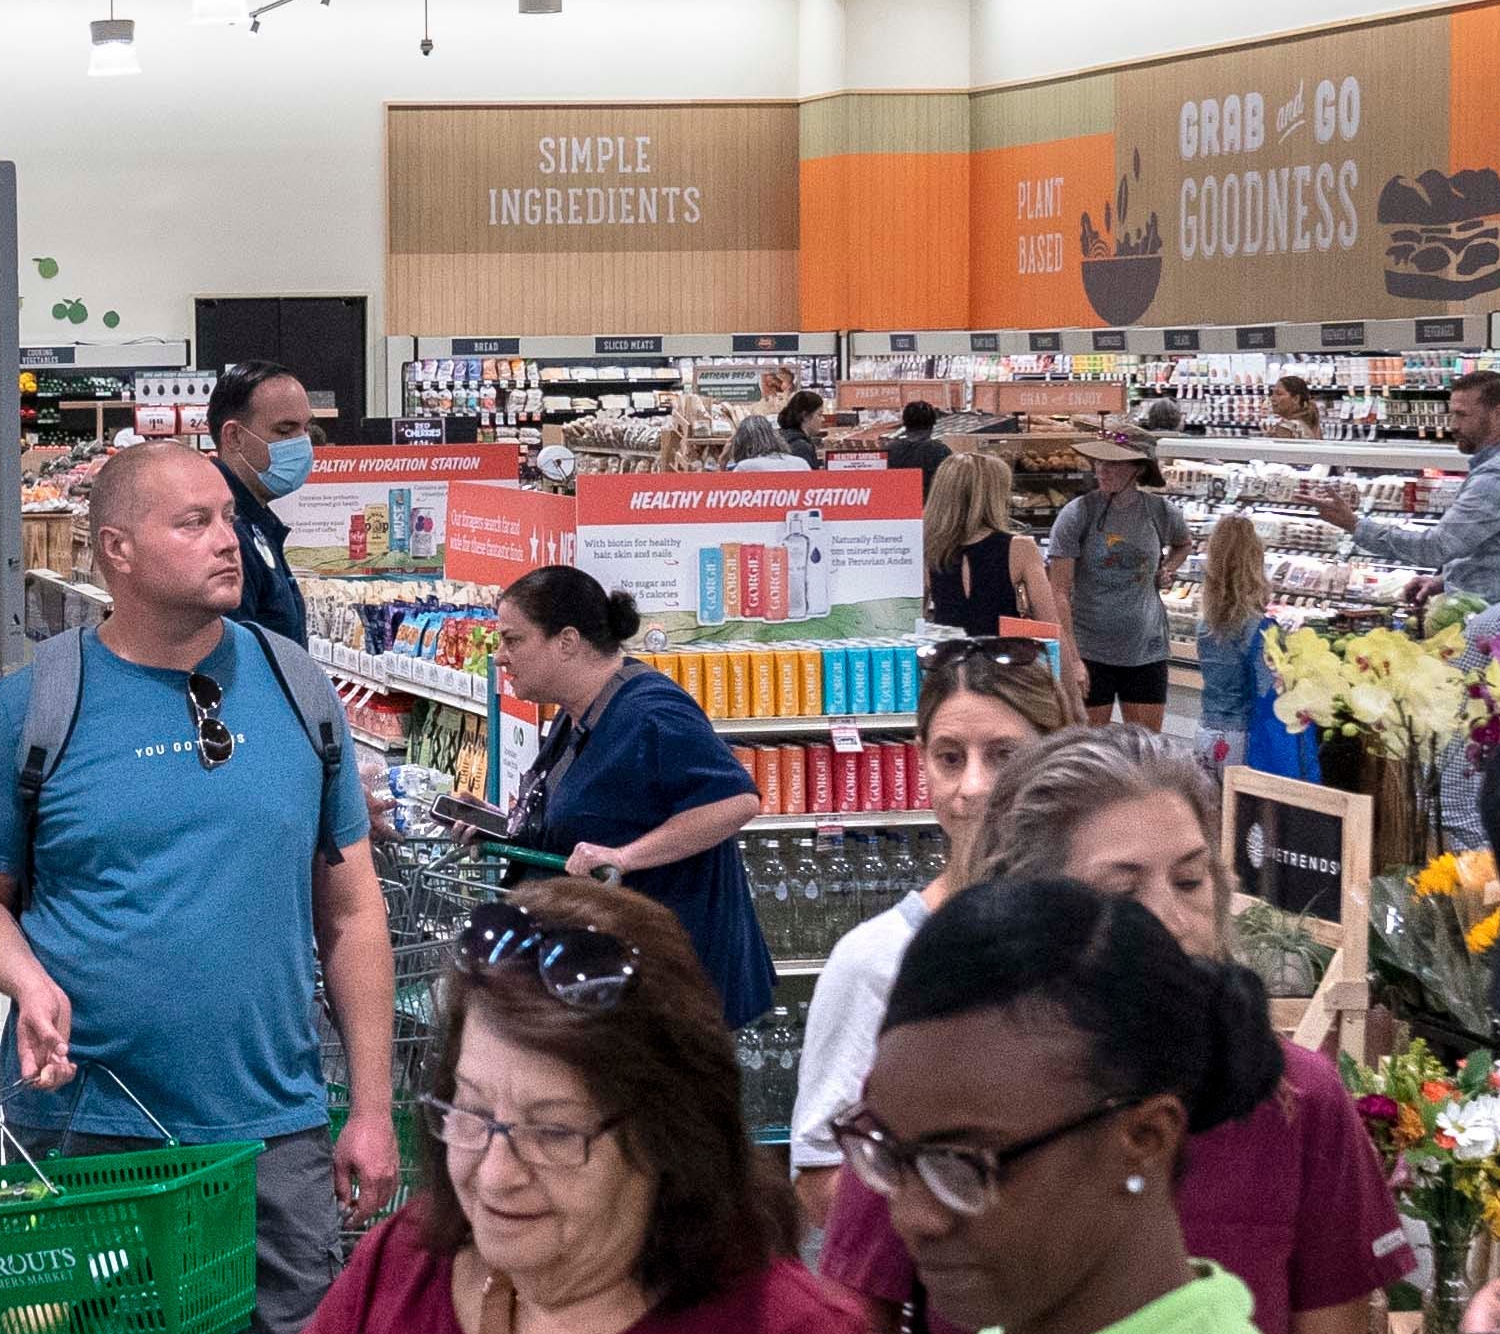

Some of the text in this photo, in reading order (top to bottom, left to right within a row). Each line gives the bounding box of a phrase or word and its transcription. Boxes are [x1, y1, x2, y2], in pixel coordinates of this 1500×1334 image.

[1179, 74, 1362, 162] GRAB and GO
[538, 135, 652, 175] SIMPLE
[1017, 176, 1065, 220] PLANT
[488, 186, 701, 225] INGREDIENTS
[1179, 159, 1360, 261] GOODNESS
[1018, 232, 1064, 274] BASED
[473, 341, 499, 353] BREAD
[603, 338, 656, 351] SLICED MEATS
[732, 370, 757, 383] BREAD
[1020, 392, 1048, 412] GRAB
[313, 455, 481, 475] EALTHY HYDRATION STATION
[630, 487, 872, 510] HEALTHY HYDRATION STATION
[584, 537, 682, 550] With biotin for healthy
[832, 534, 903, 547] Naturally filtered
[593, 548, 673, 561] hair, skin and nails
[845, 545, 911, 557] mineral springs
[832, 556, 913, 566] the Peruvian Andes
[620, 578, 677, 592] No sugar and
[646, 588, 679, 599] calories
[135, 744, 165, 758] YOU
[27, 1269, 75, 1286] MARKET
